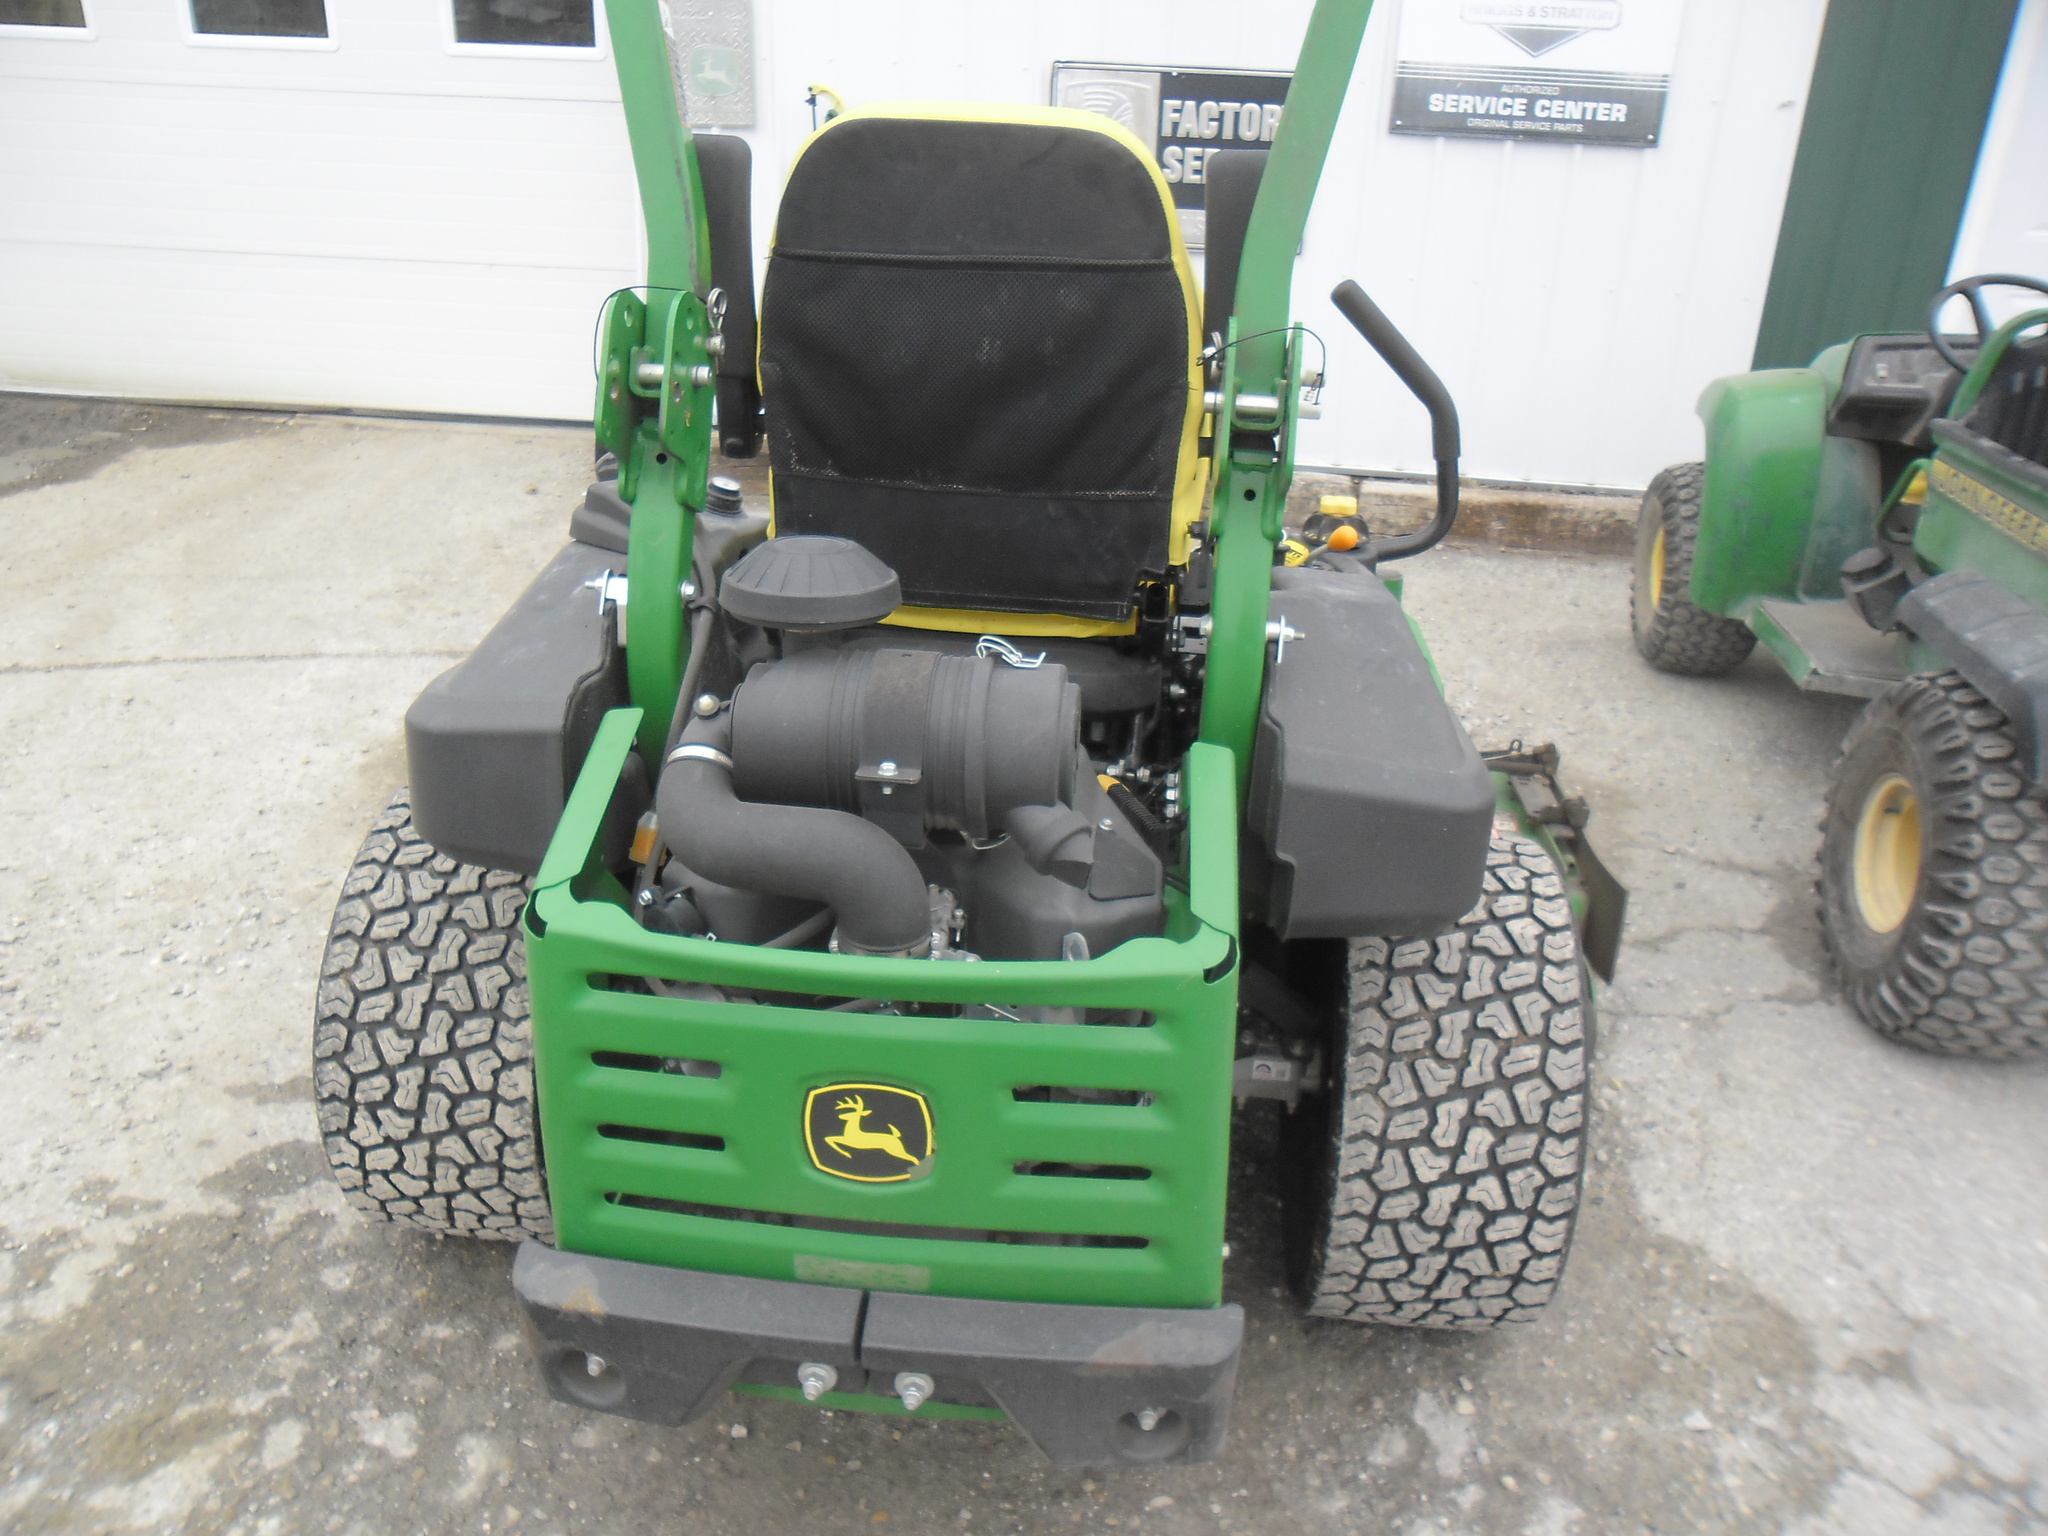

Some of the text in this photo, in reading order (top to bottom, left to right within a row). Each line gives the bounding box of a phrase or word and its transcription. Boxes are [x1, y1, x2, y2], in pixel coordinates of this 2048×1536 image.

[1527, 5, 1537, 18] &
[1501, 84, 1560, 96] AUTHORIZED
[1428, 93, 1628, 122] SERVICE CENTER
[1160, 99, 1285, 142] FACTOR
[1467, 117, 1584, 133] ORIGINAL SERVICE PARTS
